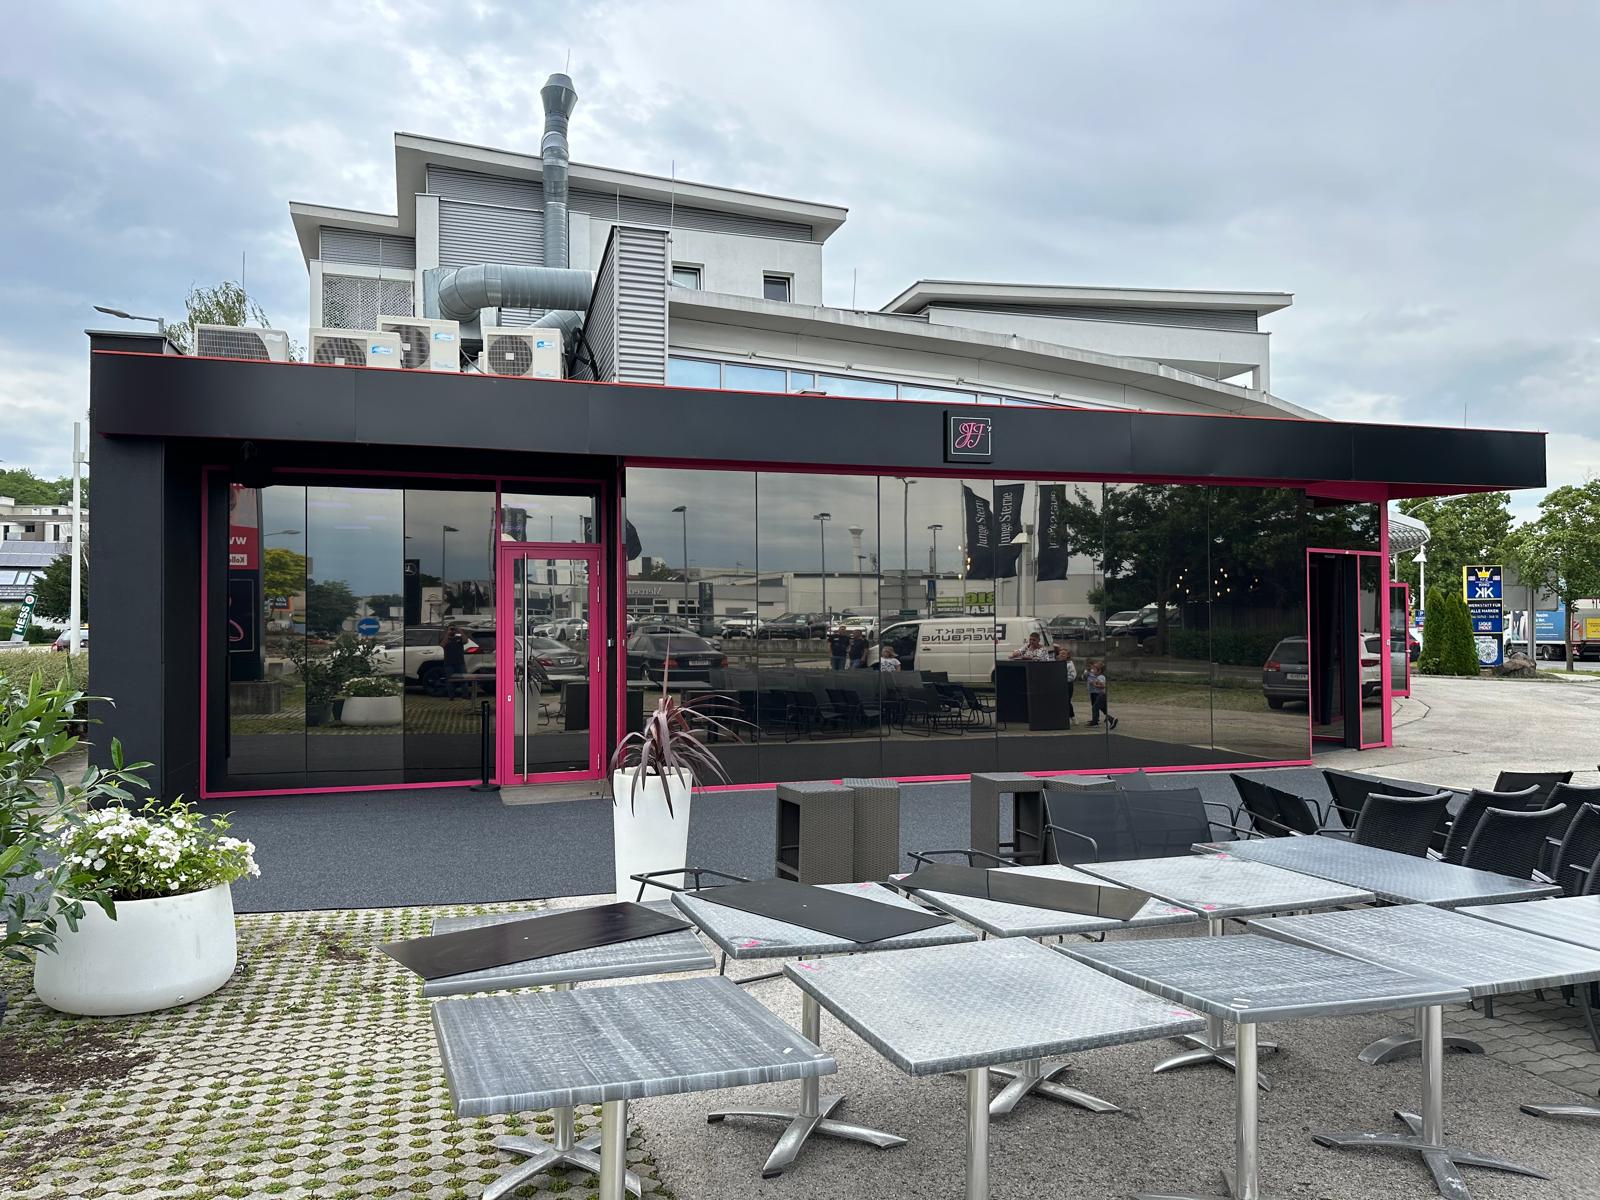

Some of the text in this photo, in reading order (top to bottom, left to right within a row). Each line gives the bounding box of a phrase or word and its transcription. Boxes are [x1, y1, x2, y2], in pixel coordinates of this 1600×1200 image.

[998, 492, 1013, 547] Junge Sterne
[976, 525, 989, 549] Junge
[14, 606, 30, 632] HESS
